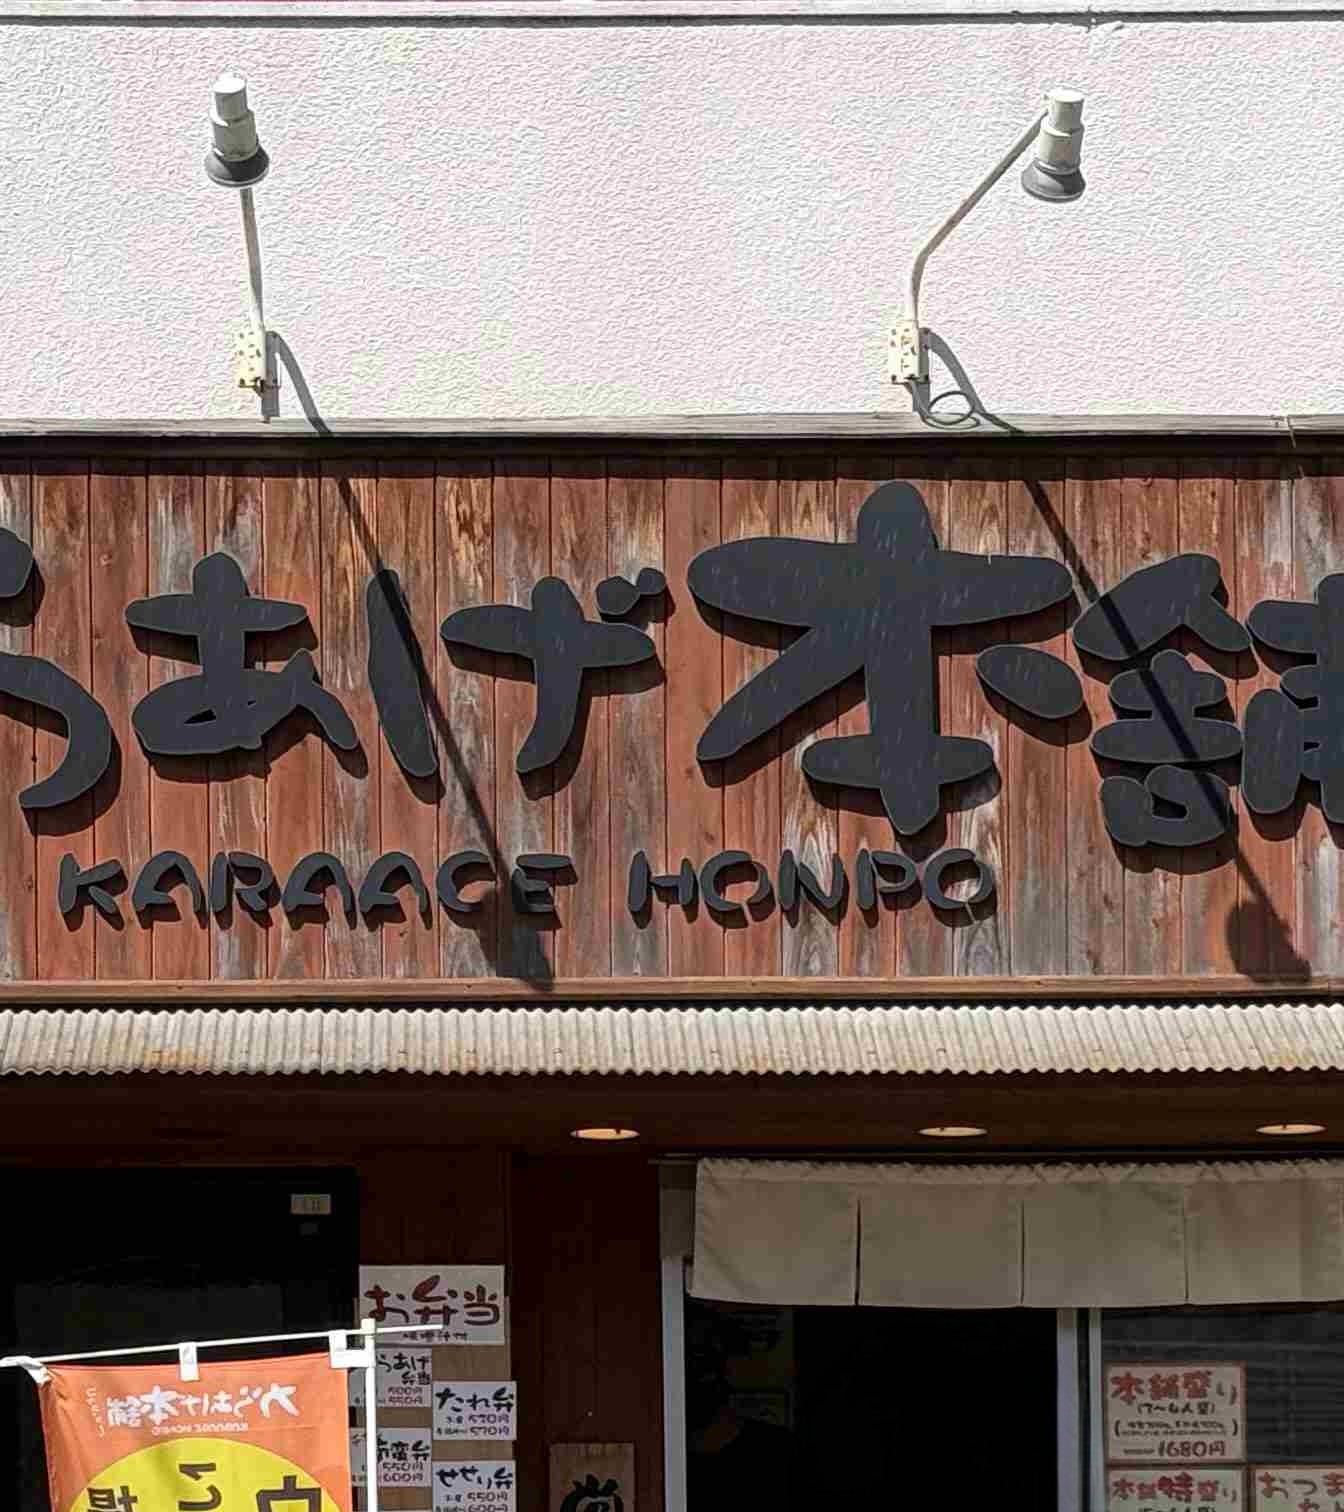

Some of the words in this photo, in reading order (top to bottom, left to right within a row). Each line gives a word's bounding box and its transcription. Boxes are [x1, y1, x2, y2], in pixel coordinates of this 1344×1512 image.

[627, 847, 994, 914] HONPO
[364, 1275, 501, 1326] お弁当
[376, 1352, 430, 1373] らあげ
